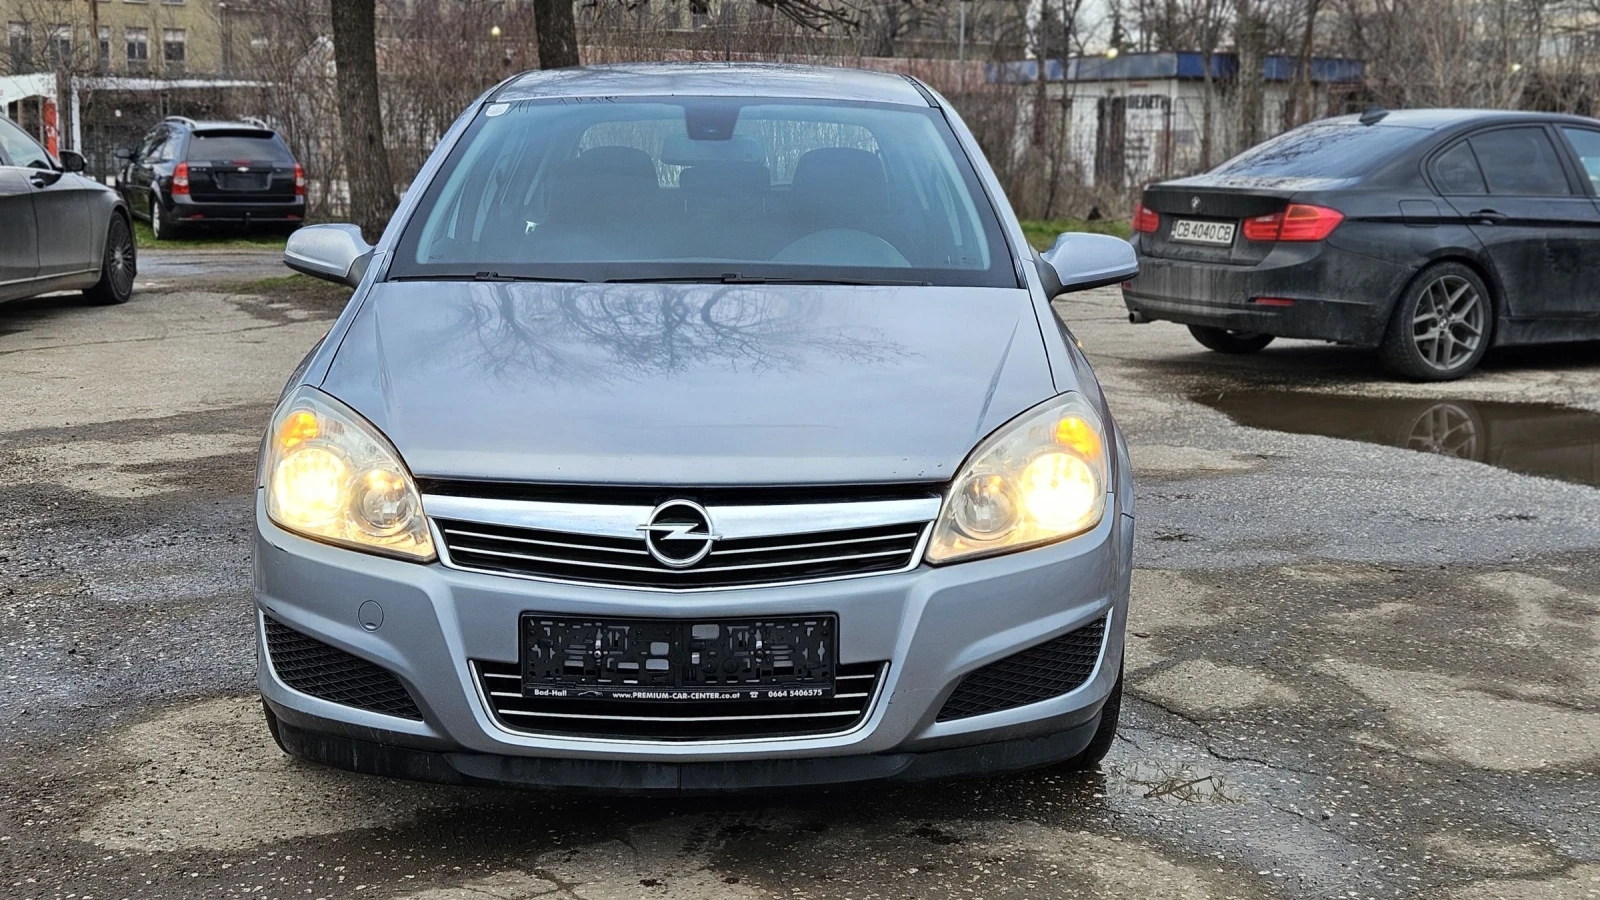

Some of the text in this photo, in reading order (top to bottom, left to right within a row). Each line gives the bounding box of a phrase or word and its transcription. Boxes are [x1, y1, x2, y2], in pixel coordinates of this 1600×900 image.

[1176, 222, 1232, 241] CB 4040 CB
[534, 689, 823, 700] Bad-Hall www.PREMIUM-CAR-CENTER.co.at 0664 5406575
